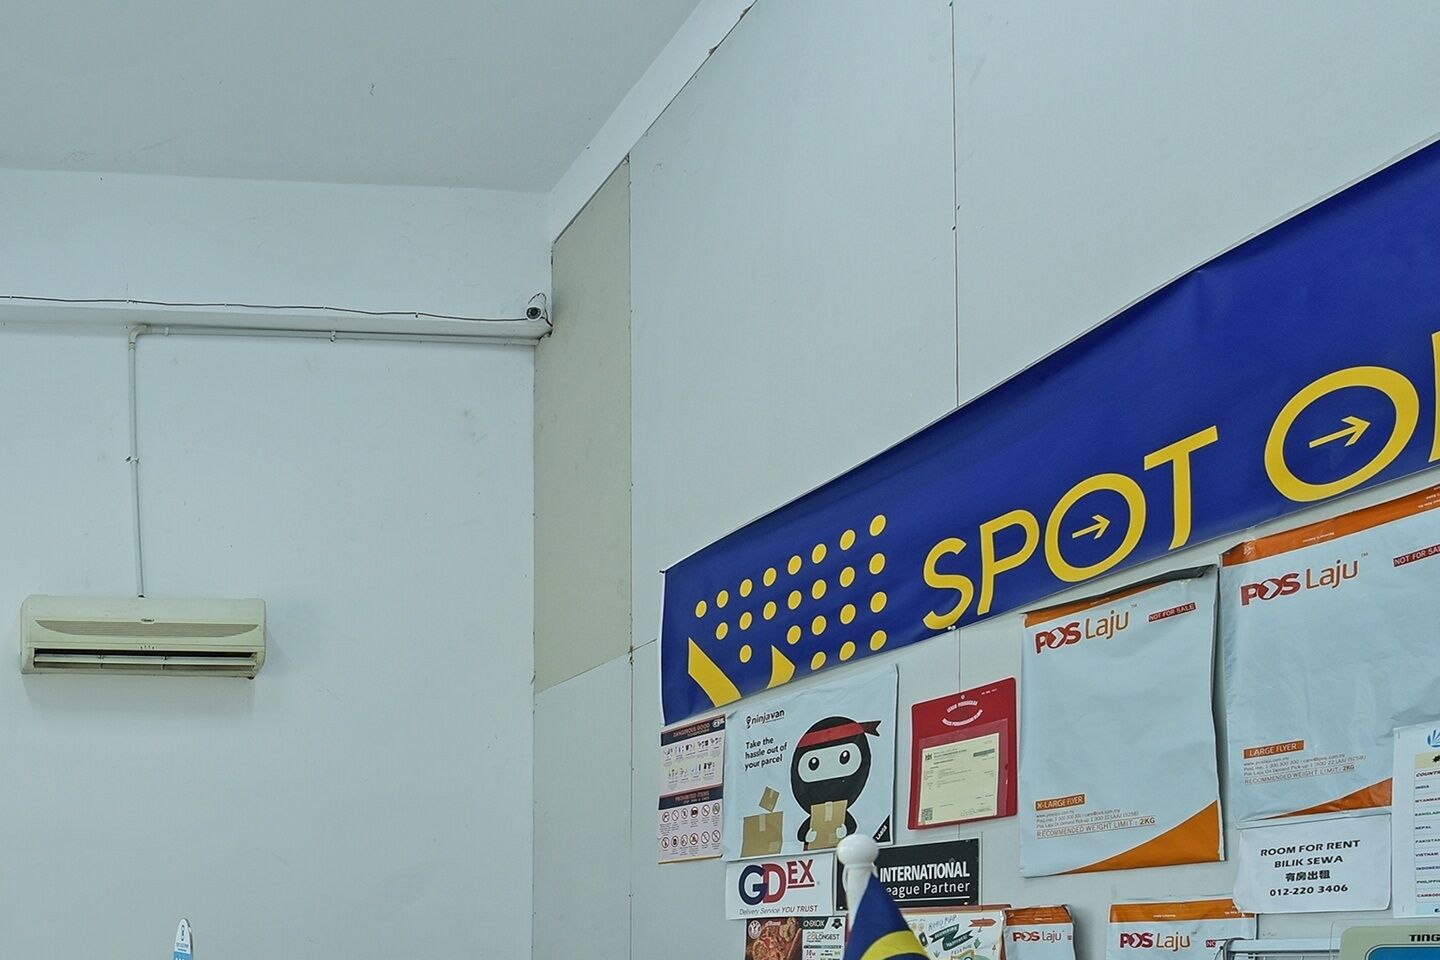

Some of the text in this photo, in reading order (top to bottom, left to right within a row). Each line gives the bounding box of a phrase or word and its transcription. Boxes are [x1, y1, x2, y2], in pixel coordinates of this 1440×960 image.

[922, 331, 1440, 630] SPOT O
[1394, 557, 1410, 565] NOT
[1412, 552, 1426, 560] FOR
[1240, 573, 1301, 606] POS
[1306, 559, 1358, 589] Laju
[1176, 604, 1194, 613] SALE
[1035, 622, 1082, 654] POS
[1085, 609, 1129, 640] Laju
[745, 742, 788, 759] hassle out of
[746, 737, 774, 750] Take the
[1249, 743, 1297, 757] LARGE FLYER
[744, 754, 783, 771] your parcel
[1139, 817, 1155, 825] 2KG
[1261, 840, 1361, 856] ROOM FOR RENT
[1274, 855, 1343, 868] BILIK SEWA
[880, 861, 970, 883] INTERNATIONAL
[738, 858, 814, 906] GDEX
[887, 881, 971, 898] eague Partner
[1269, 884, 1348, 896] 012-220 3406
[739, 904, 818, 915] Delivery Service YOU TRUST
[1012, 930, 1061, 943] POS Laju
[1120, 932, 1190, 952] POS Laju
